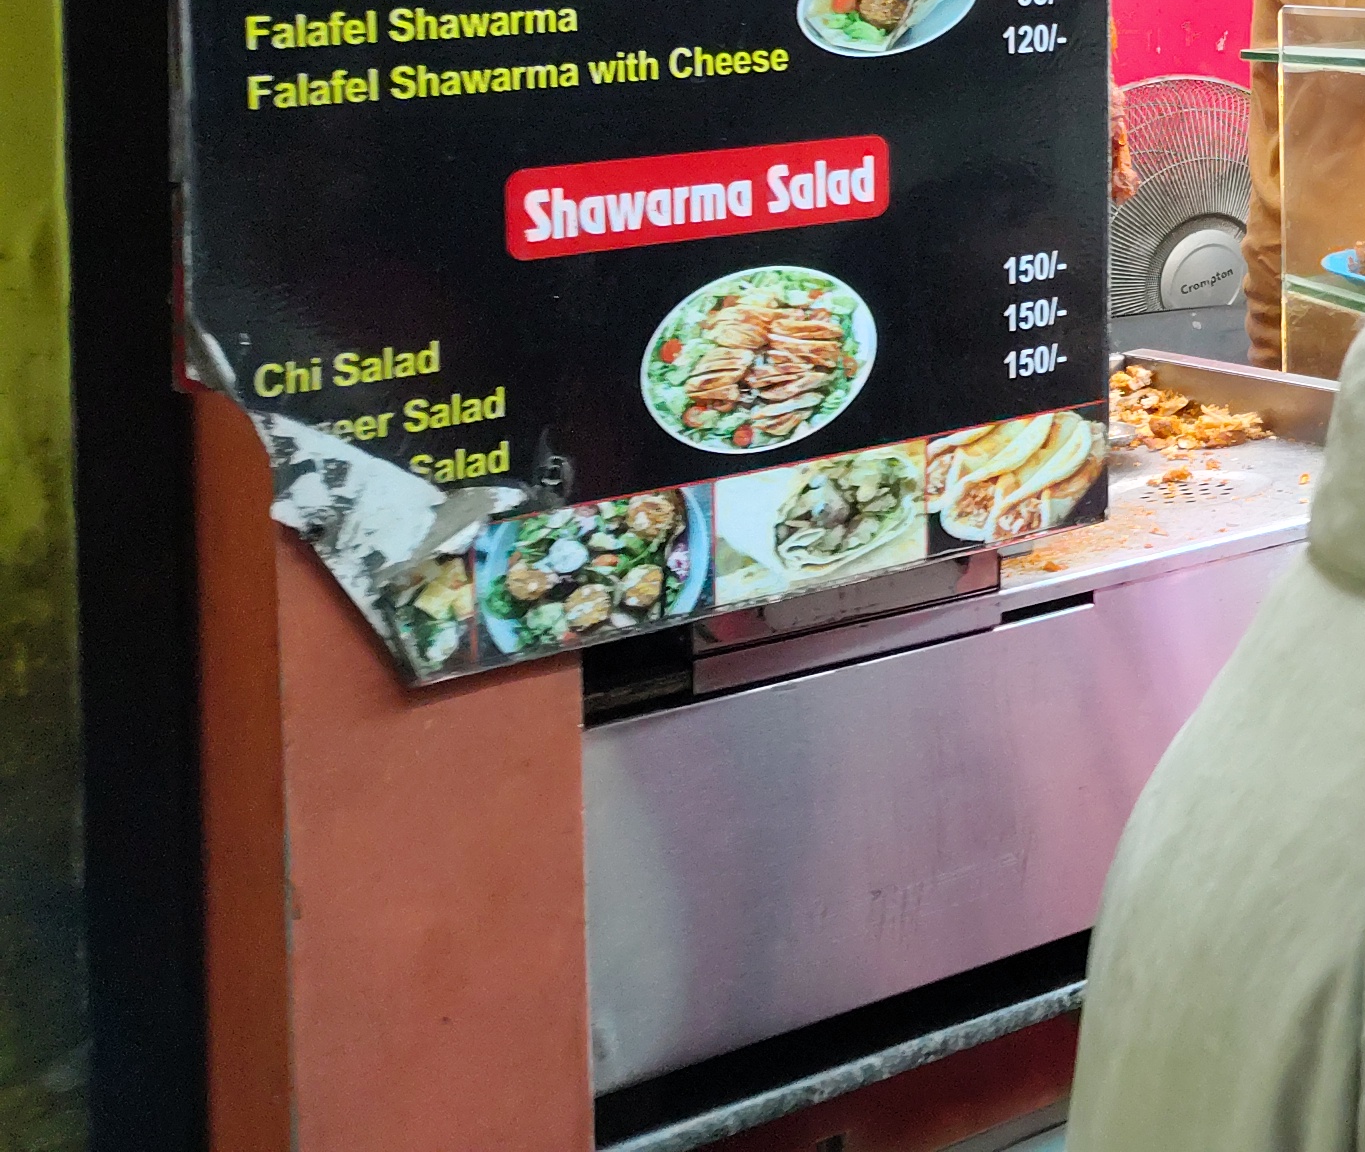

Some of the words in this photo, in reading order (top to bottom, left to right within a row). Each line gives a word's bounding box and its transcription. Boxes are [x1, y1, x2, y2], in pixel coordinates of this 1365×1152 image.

[245, 11, 379, 51] Falafel
[388, 4, 578, 43] Shawarma
[246, 70, 380, 110] Falafel
[389, 58, 579, 101] Shawarma
[590, 50, 660, 84] with
[668, 45, 789, 80] Cheese
[1002, 23, 1067, 55] 120/-
[523, 181, 753, 244] Shawarma
[766, 155, 876, 215] Salad
[253, 357, 323, 398] Chi
[333, 340, 441, 387] Salad
[1002, 250, 1067, 286] 150/-
[1181, 266, 1234, 296] Crompton
[402, 386, 507, 433] Salad
[1002, 296, 1067, 333] 150/-
[409, 440, 511, 484] Salad
[1002, 341, 1067, 380] 150/-
